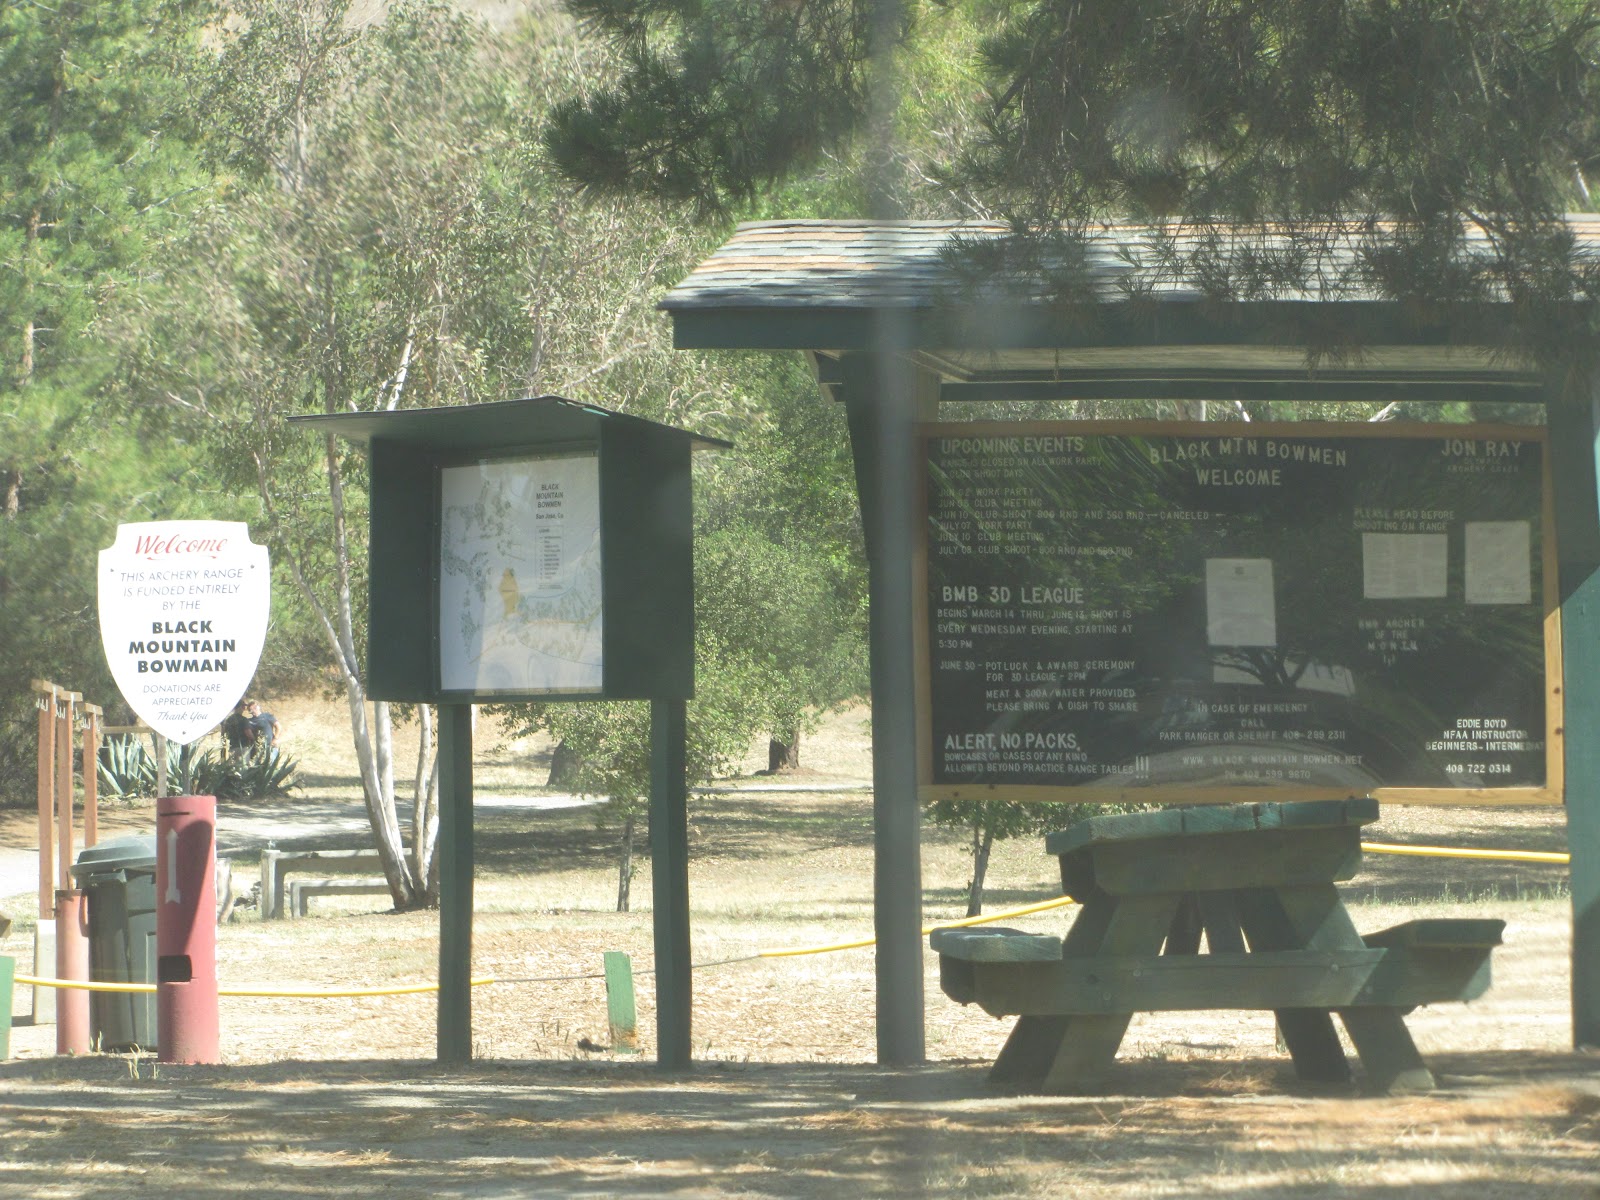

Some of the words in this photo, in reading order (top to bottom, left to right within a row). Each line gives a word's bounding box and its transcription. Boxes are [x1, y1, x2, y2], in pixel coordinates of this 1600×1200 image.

[940, 438, 1020, 454] UPCOMING
[1023, 436, 1085, 453] EVENTS
[1441, 438, 1476, 457] JON
[1485, 440, 1521, 457] RAY
[1149, 441, 1211, 464] BLACK
[1219, 437, 1257, 457] MTN
[1266, 441, 1346, 467] BOWMEN
[1048, 457, 1073, 466] WORK
[1195, 469, 1282, 487] WELCOME
[541, 483, 560, 491] BLACK
[975, 487, 1001, 497] WORK
[1004, 487, 1035, 497] PARTY
[535, 491, 565, 500] MOUNTAIN
[537, 500, 562, 509] BOWMEN
[974, 498, 998, 508] CLUB
[1003, 498, 1043, 508] MEETING
[939, 510, 957, 519] JUN
[959, 510, 969, 519] 10
[974, 510, 999, 519] CLUB
[1002, 509, 1032, 519] SHOOT
[1084, 510, 1104, 519] AND
[1160, 510, 1210, 520] CANCELED
[1420, 509, 1456, 521] BEFORE
[960, 521, 972, 530] 07
[977, 520, 1003, 531] WORK
[1006, 520, 1034, 530] PARTY
[1418, 521, 1450, 532] RANGE
[962, 532, 972, 541] 10
[977, 532, 1003, 541] CLUB
[1007, 532, 1046, 542] MEETING
[134, 533, 228, 561] Welcome
[938, 545, 959, 555] JULY
[978, 545, 1001, 554] CLUB
[1004, 545, 1032, 554] SHOOT
[1057, 546, 1077, 556] RND
[1077, 545, 1096, 555] AND
[120, 571, 146, 583] THIS
[148, 569, 200, 582] ARCHERY
[203, 568, 244, 580] RANGE
[123, 587, 134, 598] IS
[136, 585, 185, 597] FUNDED
[188, 583, 242, 596] ENTIRELY
[942, 585, 979, 603] BMB
[989, 586, 1012, 604] 3D
[1020, 587, 1085, 605] LEAGUE
[162, 600, 175, 612] BY
[179, 600, 201, 611] THE
[937, 608, 969, 619] BEGINS
[971, 608, 1003, 619] MARCH
[1004, 609, 1015, 619] 14
[1020, 609, 1045, 620] THRU
[1051, 610, 1074, 620] JUNE
[1090, 610, 1119, 619] SHOOT
[1122, 610, 1133, 619] IS
[151, 619, 214, 635] BLACK
[937, 623, 967, 634] EVERY
[970, 624, 1028, 635] WEDNESDAY
[1074, 624, 1118, 635] STARTING
[1121, 624, 1134, 634] AT
[1385, 617, 1426, 630] ARCHER
[1391, 630, 1409, 641] THE
[127, 638, 237, 655] MOUNTAIN
[938, 639, 959, 649] 5:30
[960, 639, 974, 649] PM
[136, 658, 229, 674] BOWMAN
[940, 660, 962, 671] JUNE
[964, 660, 976, 671] 30
[1036, 661, 1043, 671] &
[1046, 660, 1080, 671] AWARD
[1085, 660, 1137, 671] CEREMONY
[985, 672, 1005, 683] FOR
[1011, 672, 1023, 683] 3D
[1025, 672, 1058, 682] LEAGUE
[142, 683, 202, 695] DONATIONS
[203, 683, 222, 693] ARE
[985, 689, 1011, 699] MEAT
[1089, 688, 1137, 699] PROVIDED
[151, 697, 213, 707] APPRECIATED
[986, 702, 1021, 713] PLEASE
[1022, 702, 1051, 712] BRING
[1057, 702, 1065, 712] A
[1067, 701, 1089, 711] DISH
[1092, 701, 1106, 711] TO
[1108, 702, 1139, 713] SHARE
[1197, 703, 1209, 713] IN
[1211, 703, 1237, 714] CASE
[1238, 704, 1251, 714] OF
[1253, 703, 1308, 714] EMERGENCY
[157, 710, 188, 722] Thank
[189, 710, 209, 722] You
[1456, 718, 1482, 729] EDDIE
[1483, 718, 1508, 729] BOYD
[1000, 732, 1021, 749] NO
[1159, 731, 1183, 742] PARK
[1184, 731, 1221, 742] RANGER
[1222, 731, 1237, 742] OR
[1327, 730, 1347, 741] 2311
[1443, 729, 1469, 741] NFAA
[1470, 729, 1530, 741] INSTRUCTOR
[1002, 751, 1033, 761] CASES
[1033, 751, 1046, 761] OF
[1045, 751, 1064, 762] ANY
[1251, 753, 1298, 765] MOUNTAIN
[943, 762, 985, 773] ALLOWED
[985, 762, 1022, 773] BEYOND
[1022, 762, 1066, 774] PRACTICE
[1067, 762, 1099, 775] RANGE
[1445, 764, 1464, 775] 408
[1466, 764, 1486, 775] 722
[1488, 764, 1513, 775] 0314
